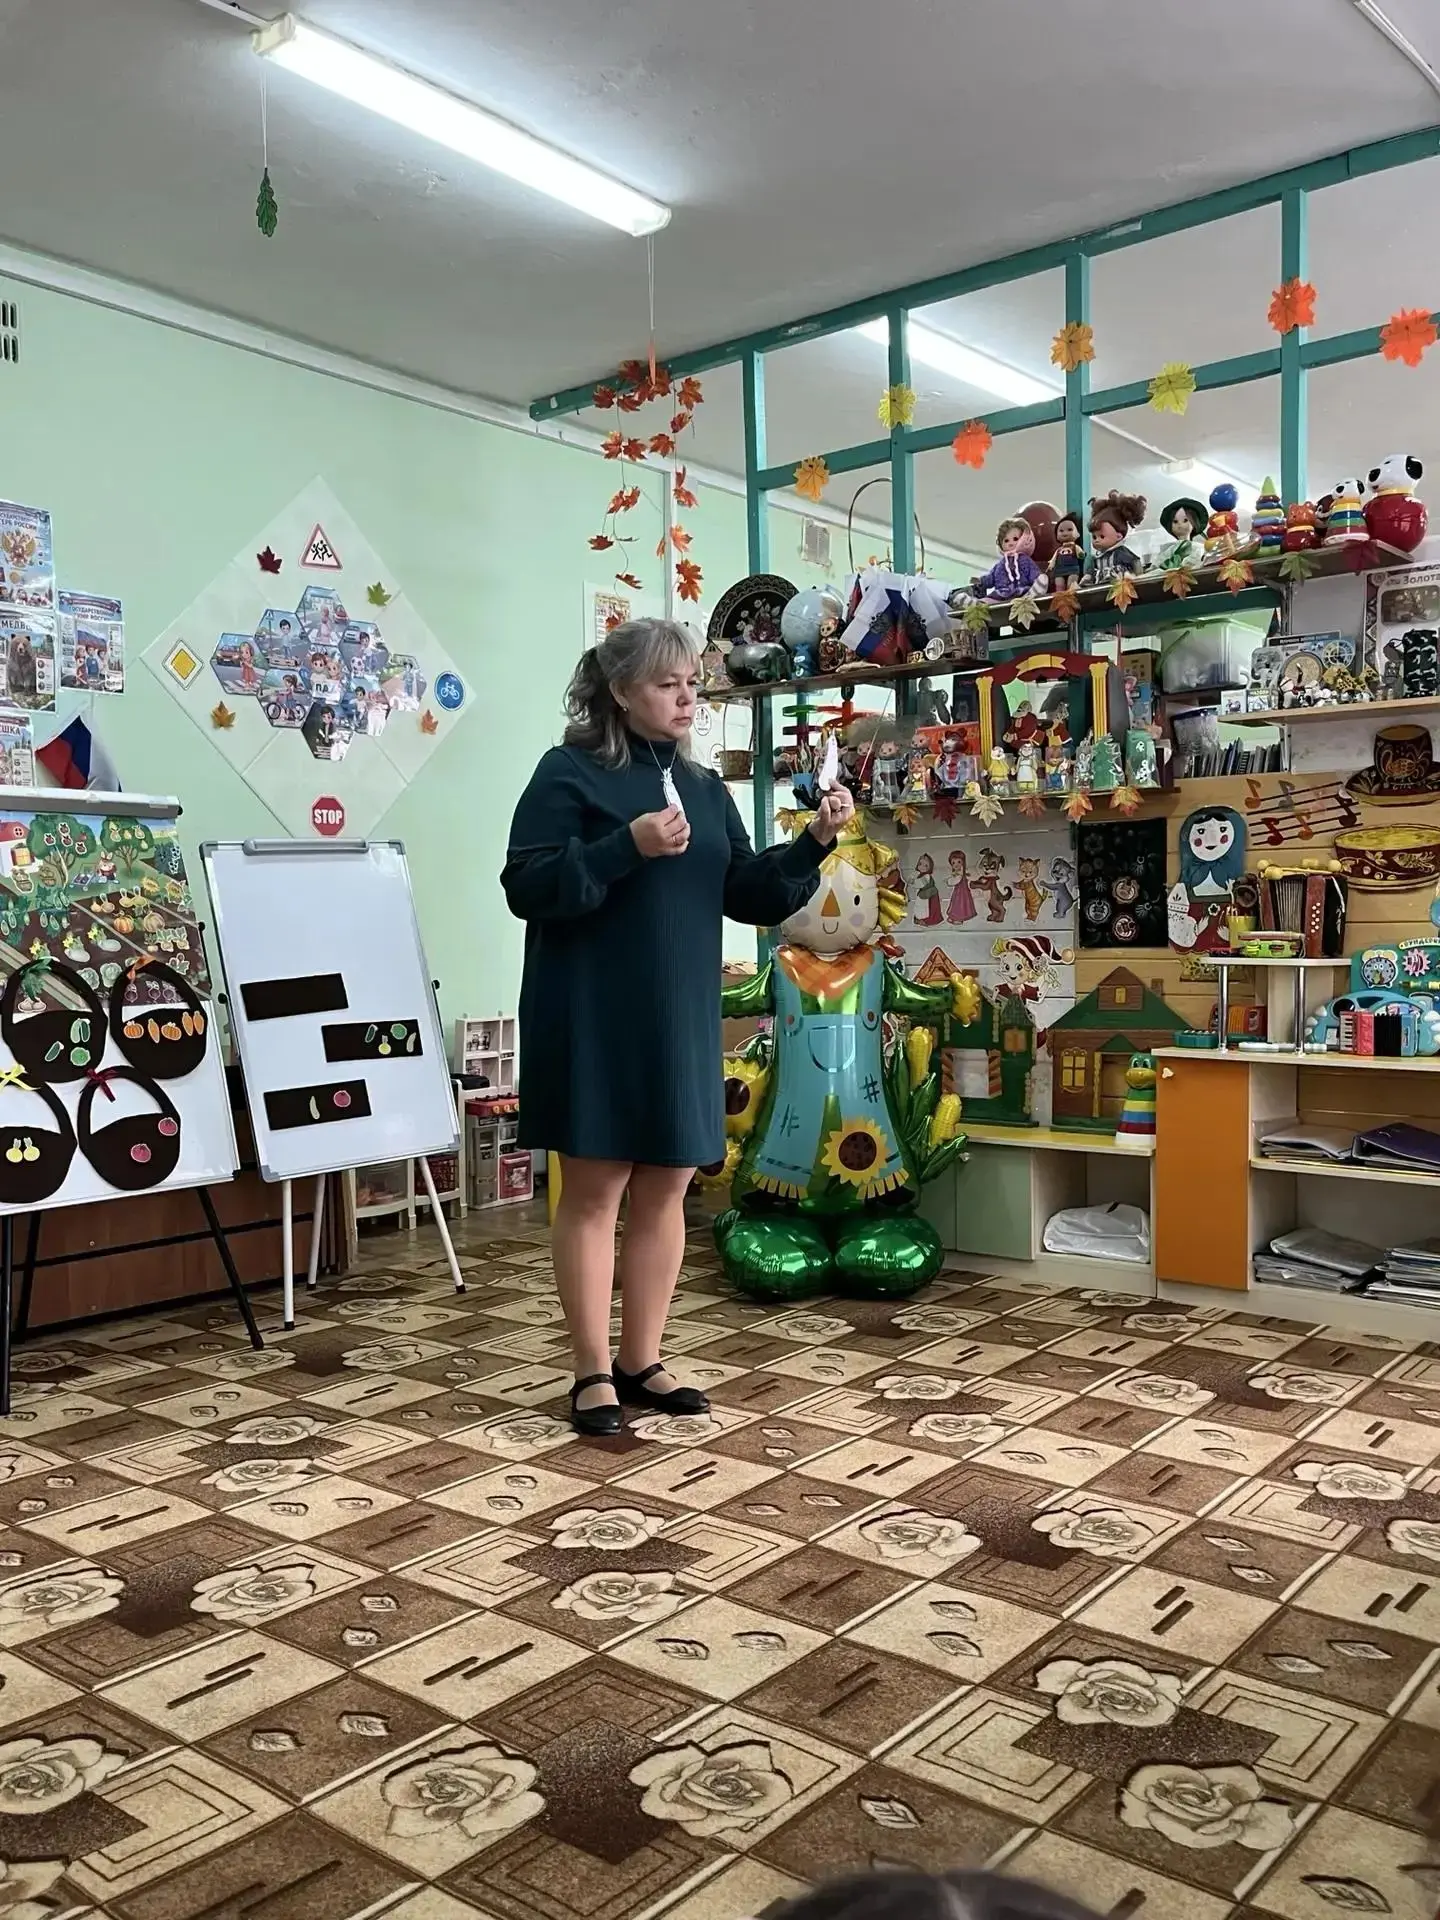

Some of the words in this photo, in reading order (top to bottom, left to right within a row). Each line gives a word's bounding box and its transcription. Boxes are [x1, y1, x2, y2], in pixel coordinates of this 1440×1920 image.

[1, 619, 33, 631] МЕДВ
[0, 724, 20, 735] ШКА
[314, 809, 343, 824] STOP
